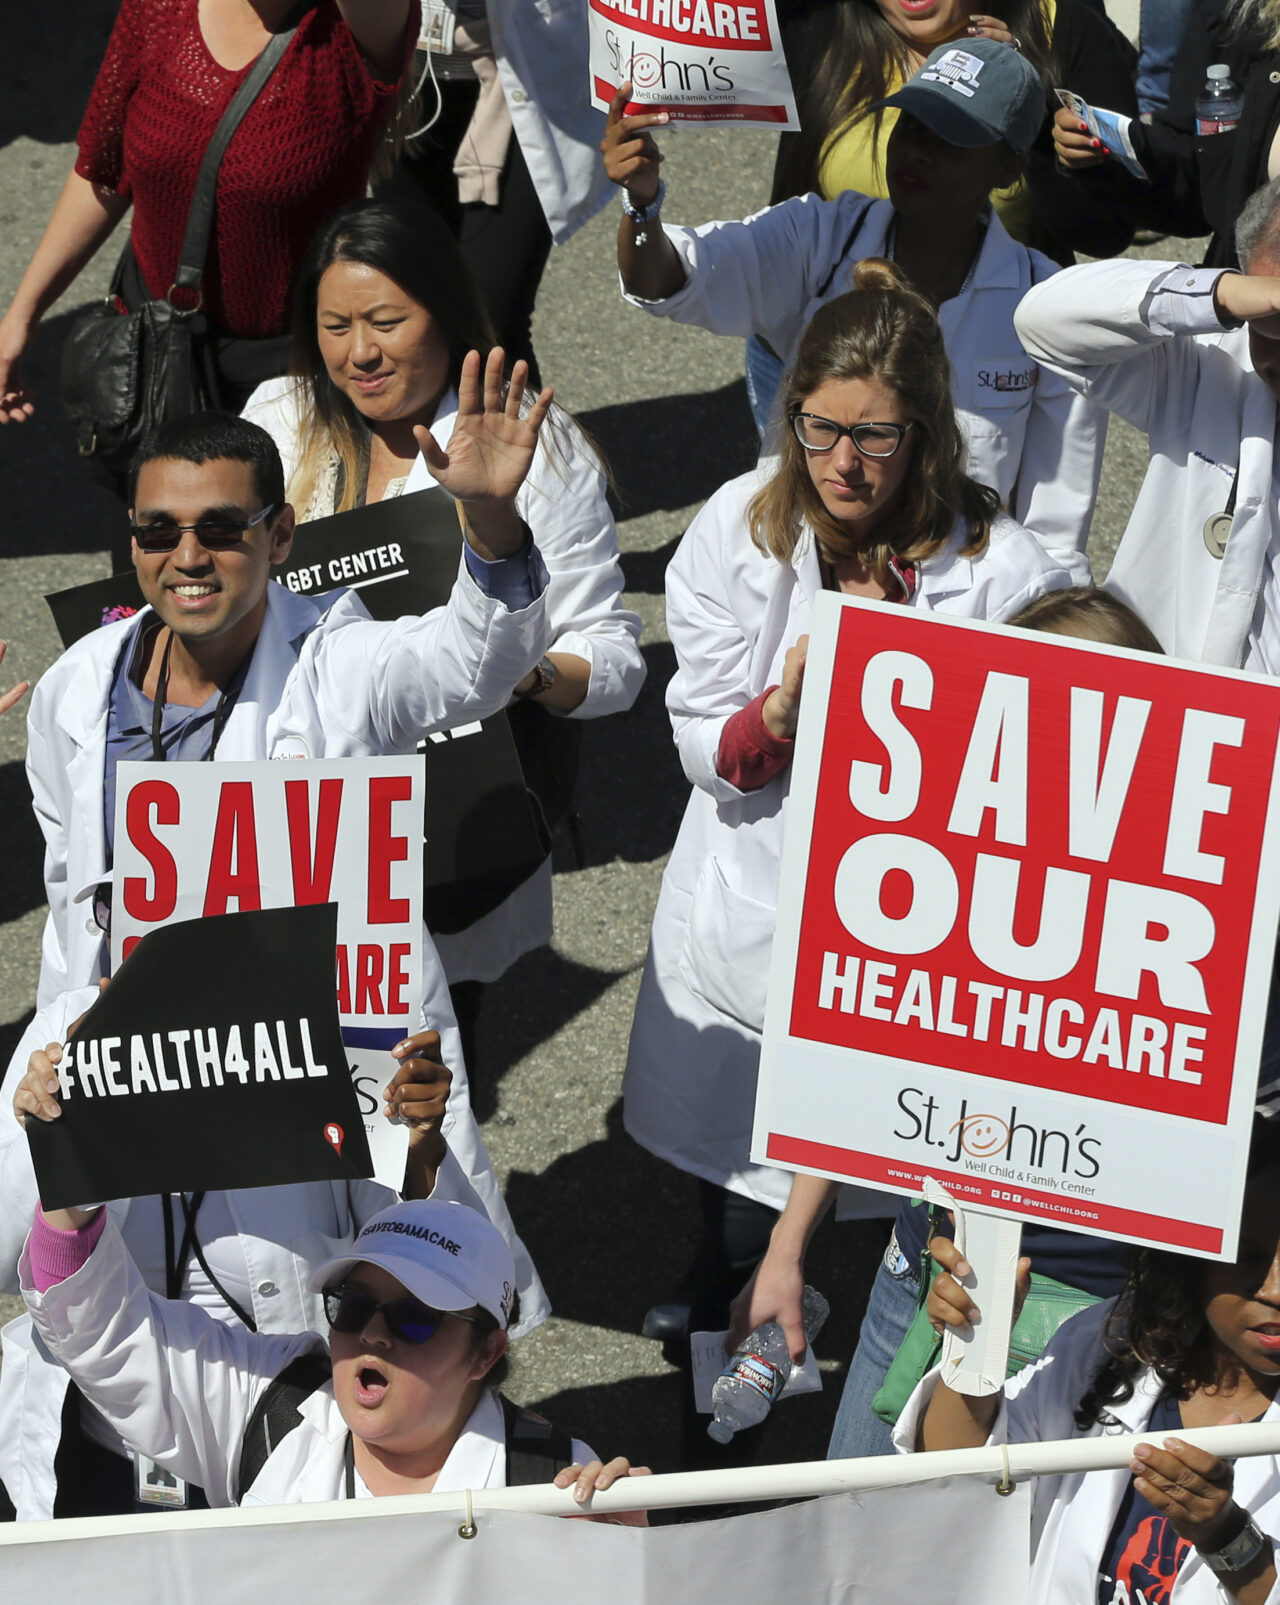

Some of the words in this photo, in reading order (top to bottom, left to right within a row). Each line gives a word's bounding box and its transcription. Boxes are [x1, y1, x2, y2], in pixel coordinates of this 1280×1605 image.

[328, 542, 405, 582] CENTER
[848, 649, 1246, 886] SAVE
[122, 776, 413, 925] SAVE
[834, 832, 1213, 1016] OUR
[54, 1016, 329, 1100] #HEALTH4ALL
[817, 950, 1209, 1087] HEALTHCARE
[893, 1087, 946, 1148] St.
[945, 1099, 1103, 1179] John's
[964, 1159, 987, 1175] Well
[988, 1164, 1016, 1181] Child
[1016, 1170, 1025, 1182] &
[1026, 1173, 1059, 1191] Family
[1060, 1180, 1097, 1197] Center
[1022, 1197, 1100, 1221] @WELLCHILDORG
[361, 1220, 463, 1258] SAVEOBAMACARE
